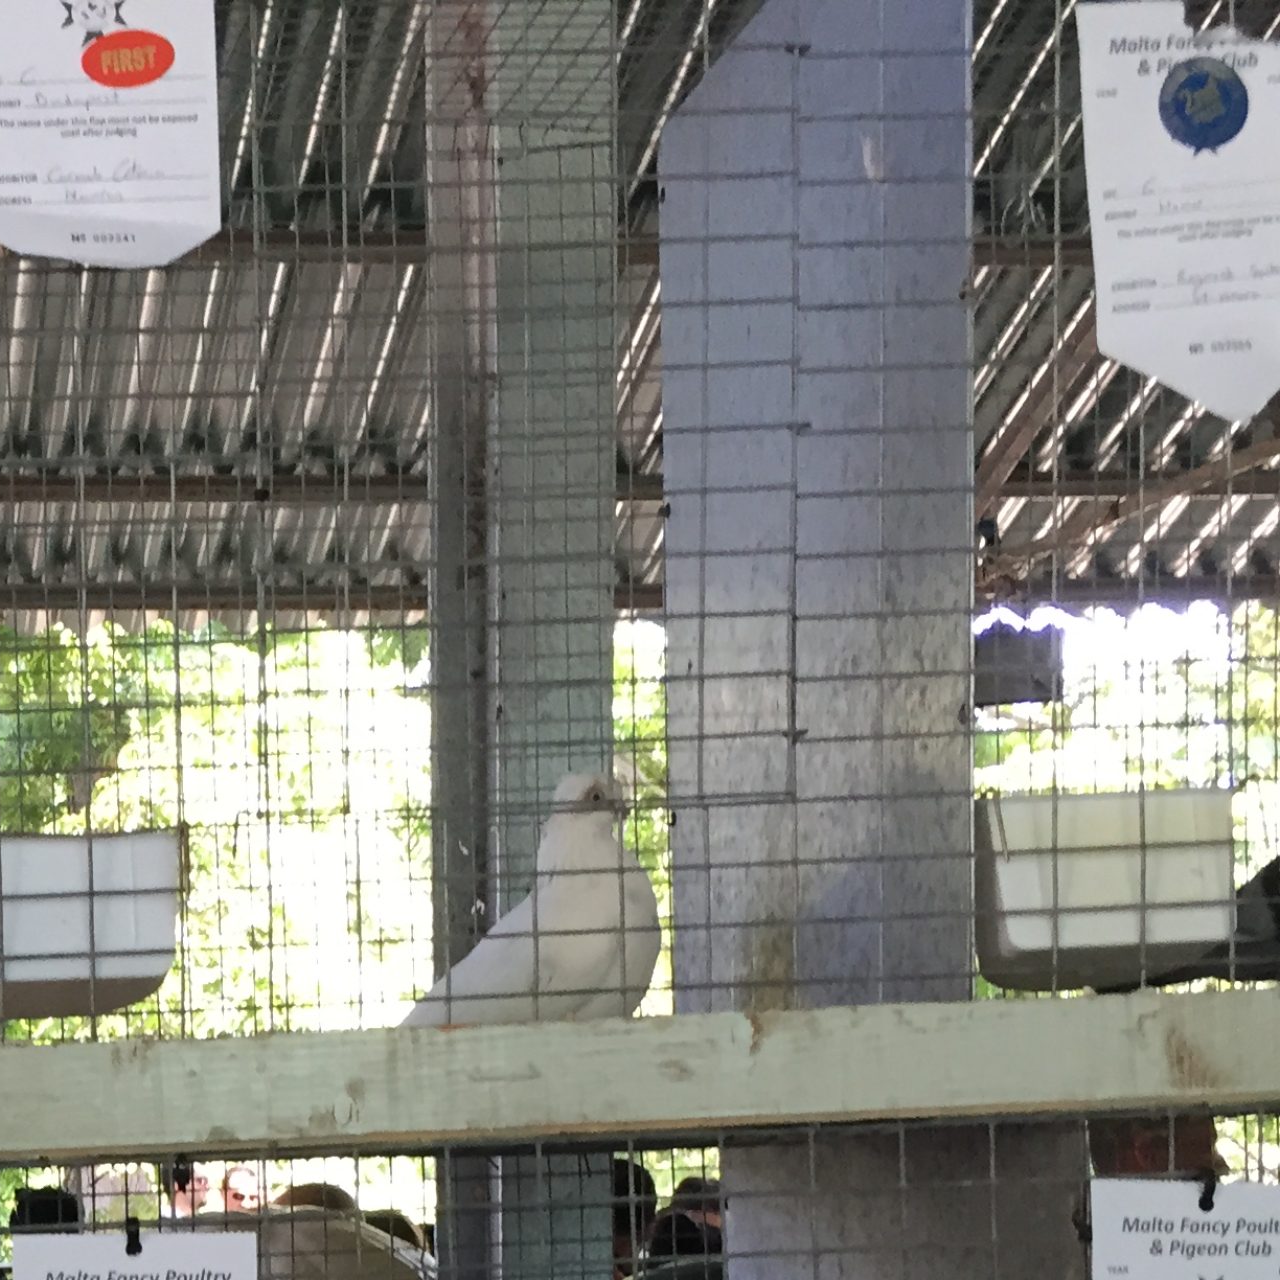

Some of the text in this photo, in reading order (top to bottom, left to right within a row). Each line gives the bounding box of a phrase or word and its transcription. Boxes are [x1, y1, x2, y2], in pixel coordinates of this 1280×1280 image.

[1109, 35, 1161, 55] Malta
[100, 45, 157, 75] FIRST
[1137, 58, 1150, 76] &
[1122, 1217, 1280, 1238] Malta Fancy Poult
[1149, 1239, 1272, 1260] & Pigeon Club
